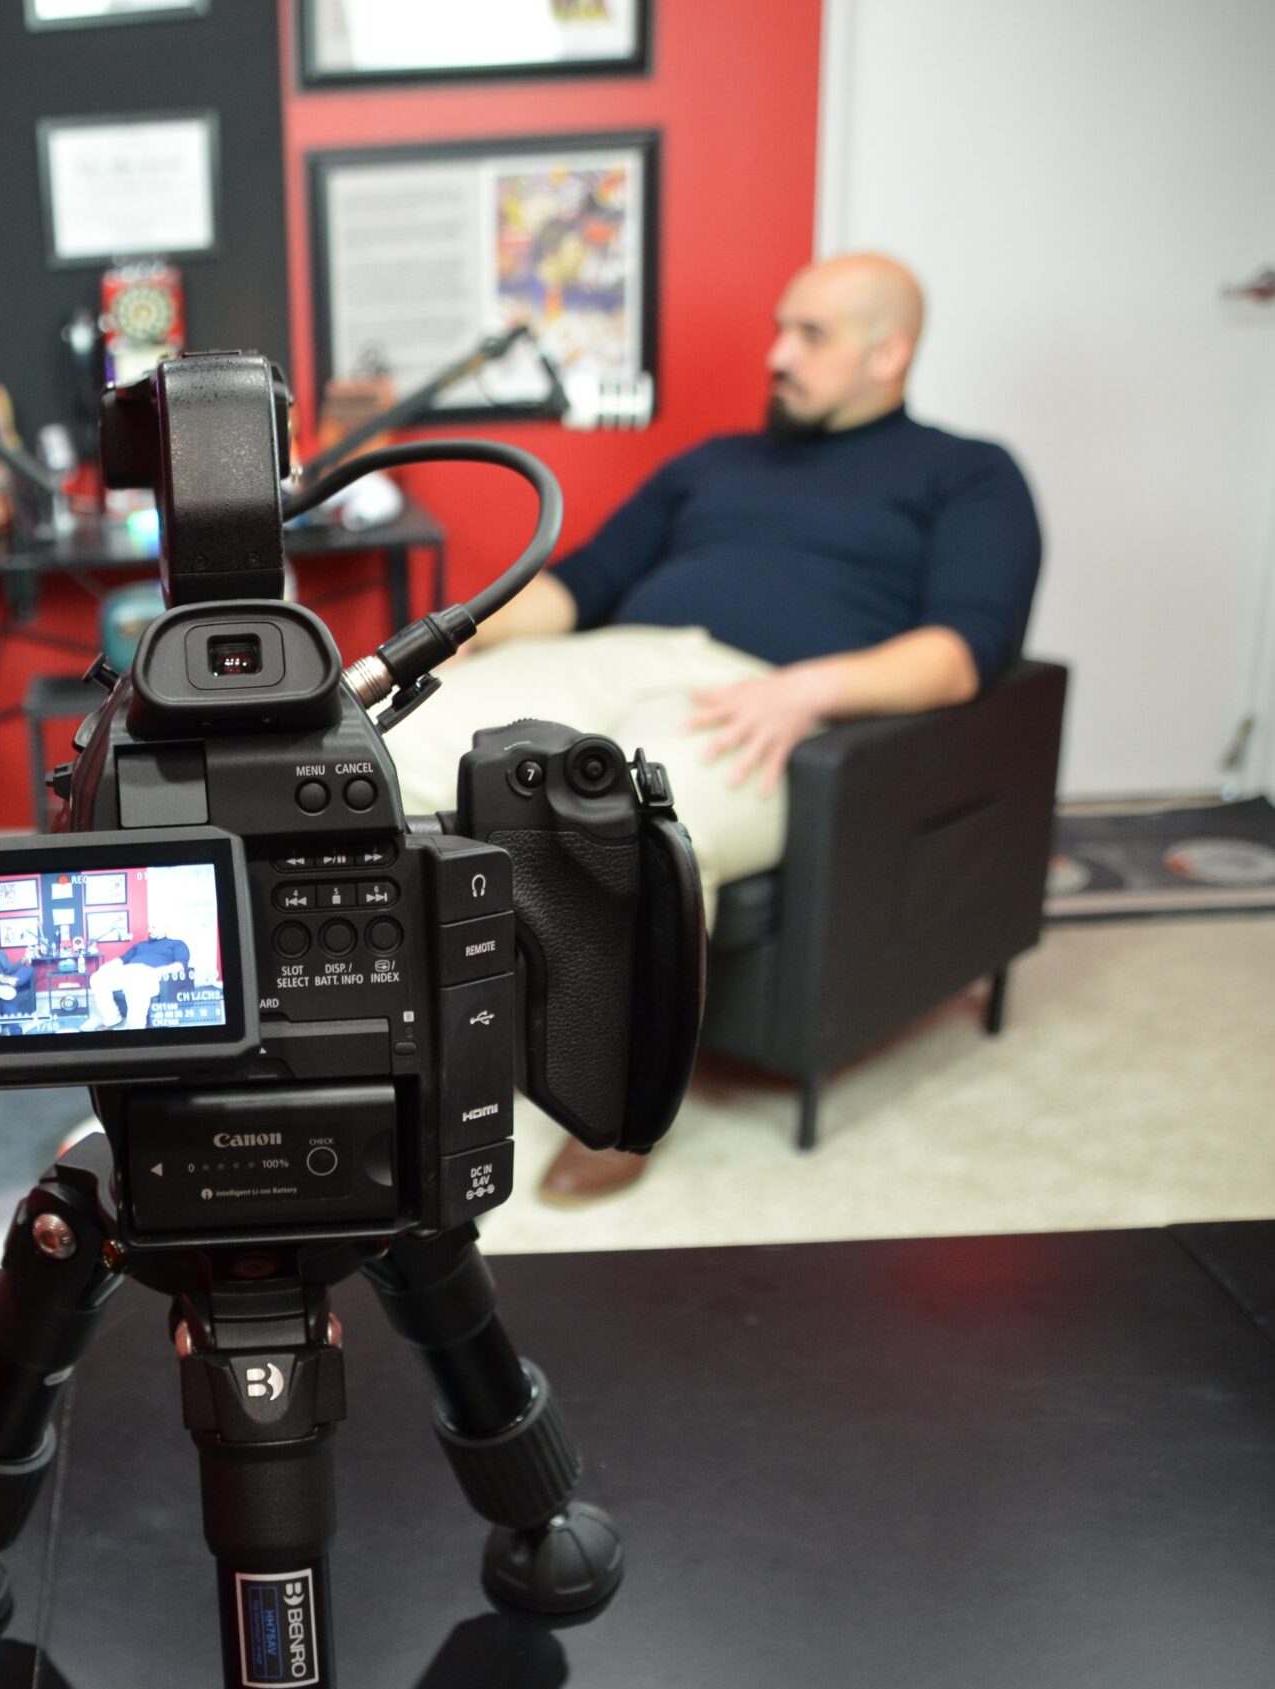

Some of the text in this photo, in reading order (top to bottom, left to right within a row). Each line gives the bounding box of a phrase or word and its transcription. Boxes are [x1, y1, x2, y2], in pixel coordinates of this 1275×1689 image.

[296, 762, 374, 776] MENU CANCEL
[527, 768, 535, 781] 7
[466, 940, 496, 956] REMOTE
[282, 965, 304, 976] SLOT
[277, 977, 309, 988] SELECT
[315, 974, 363, 986] BATT. INFO
[370, 972, 400, 983] INDEX
[462, 1103, 498, 1122] HDMI
[213, 1132, 282, 1148] Canon
[262, 1159, 289, 1169] 100%
[470, 1163, 492, 1178] DC IN
[472, 1175, 490, 1188] 8.4V
[288, 1607, 308, 1678] BENRO
